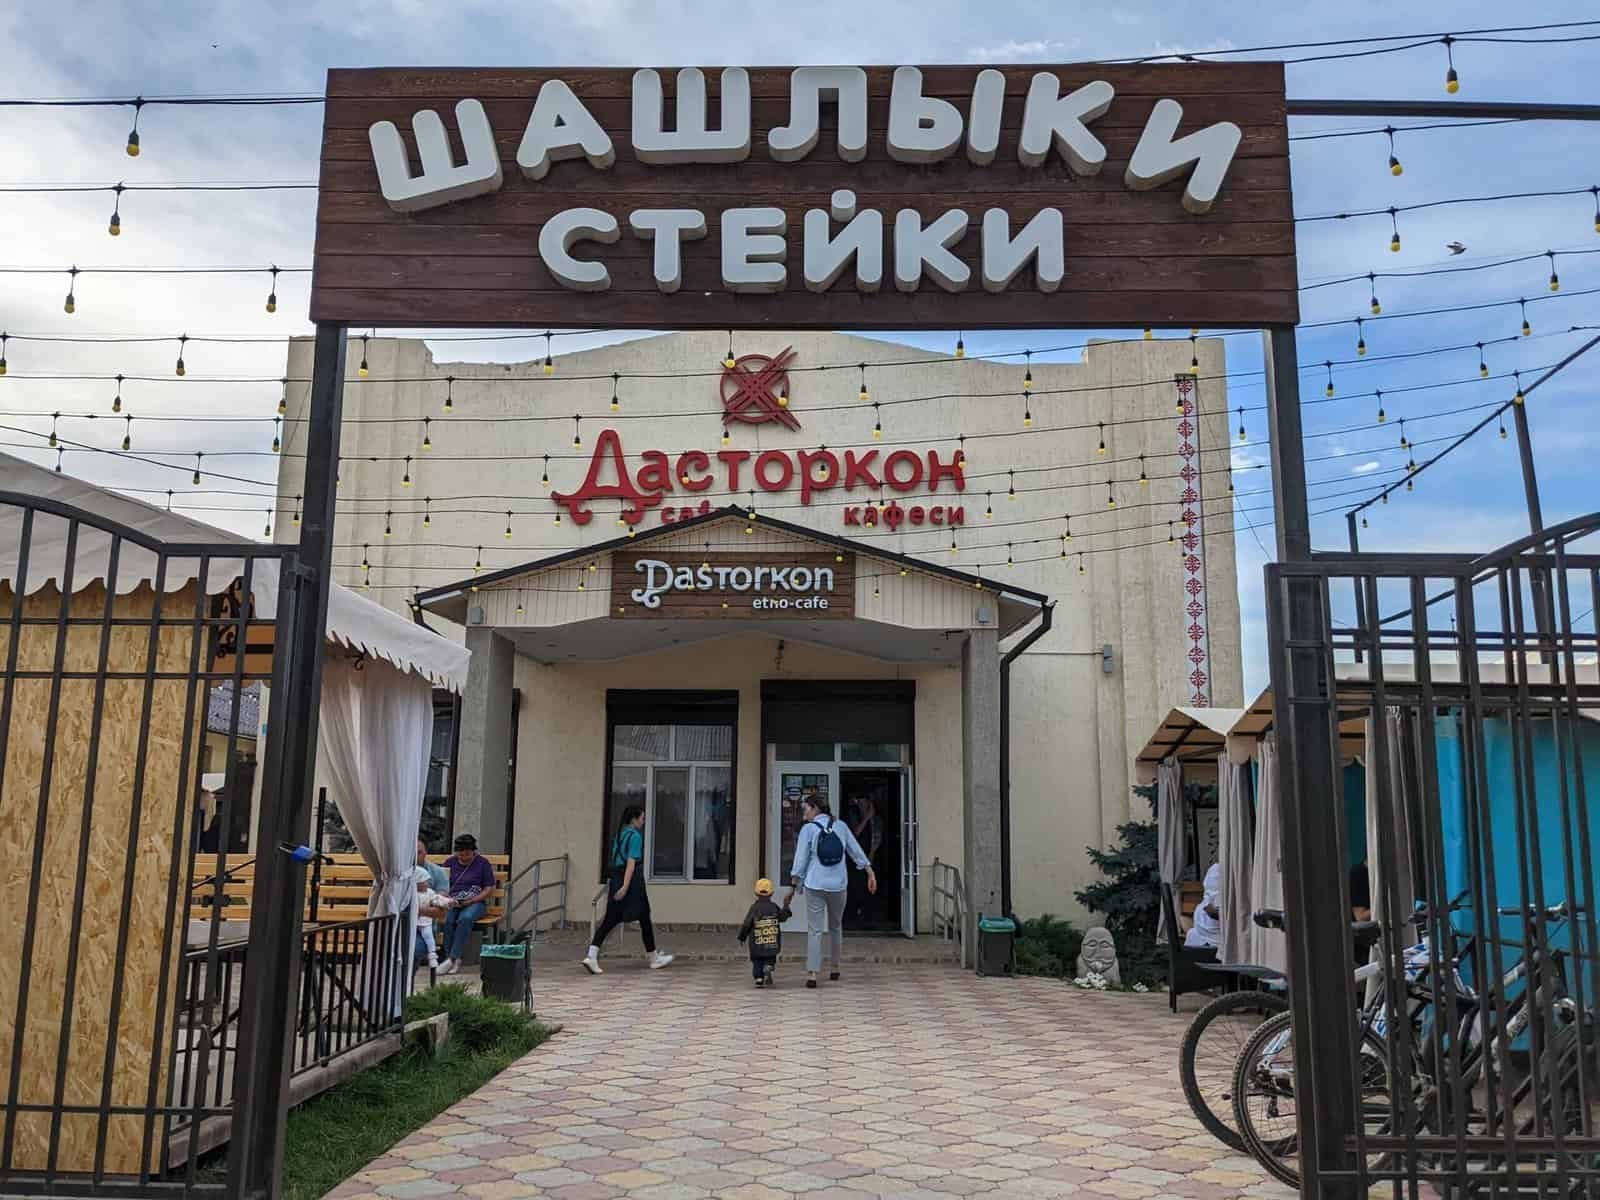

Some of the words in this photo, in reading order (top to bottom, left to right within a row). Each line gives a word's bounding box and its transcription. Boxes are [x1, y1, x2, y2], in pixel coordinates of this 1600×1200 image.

[368, 66, 1242, 214] ШАШЛЫКИ
[538, 189, 1065, 294] СТЕЙКИ
[551, 429, 966, 526] Дасторкон
[661, 500, 720, 523] caf
[844, 500, 964, 532] кафеси
[631, 559, 834, 608] Dastorkon
[752, 596, 829, 609] etno-cafe
